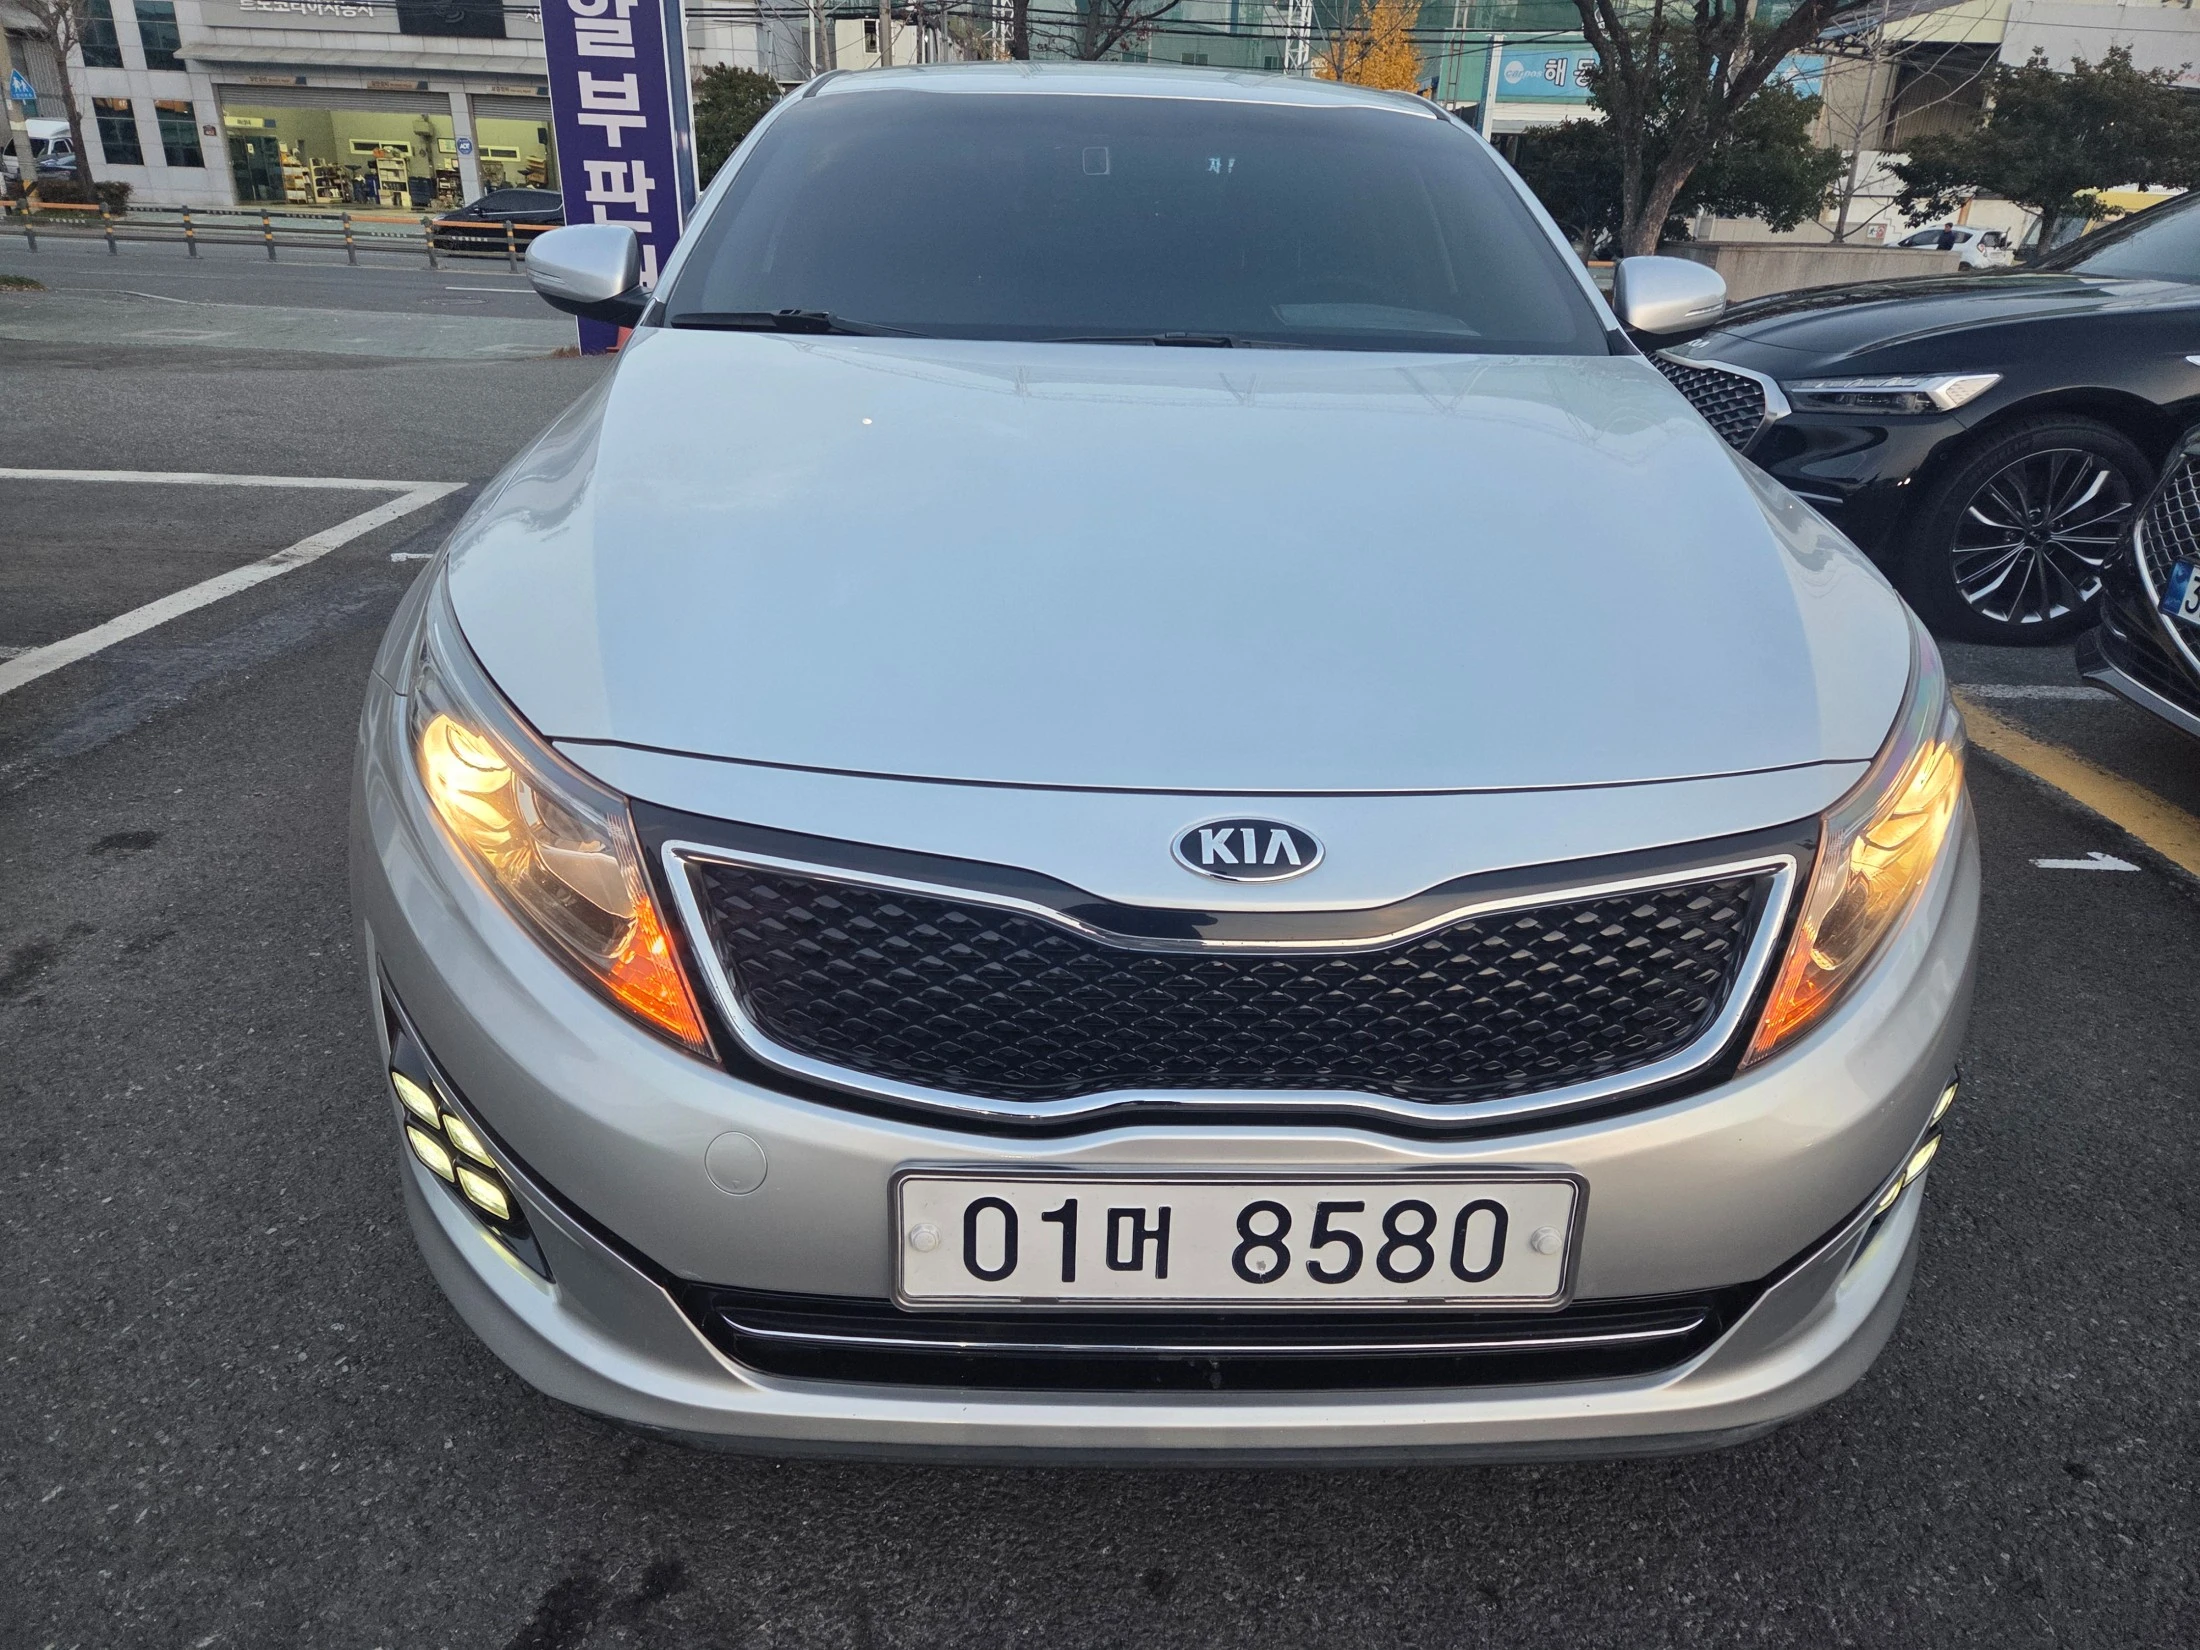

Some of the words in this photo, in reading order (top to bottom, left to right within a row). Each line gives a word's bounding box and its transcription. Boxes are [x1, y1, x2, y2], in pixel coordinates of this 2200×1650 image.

[1199, 828, 1301, 865] KIA
[963, 1197, 1171, 1284] 01머
[1231, 1199, 1509, 1284] 8580
